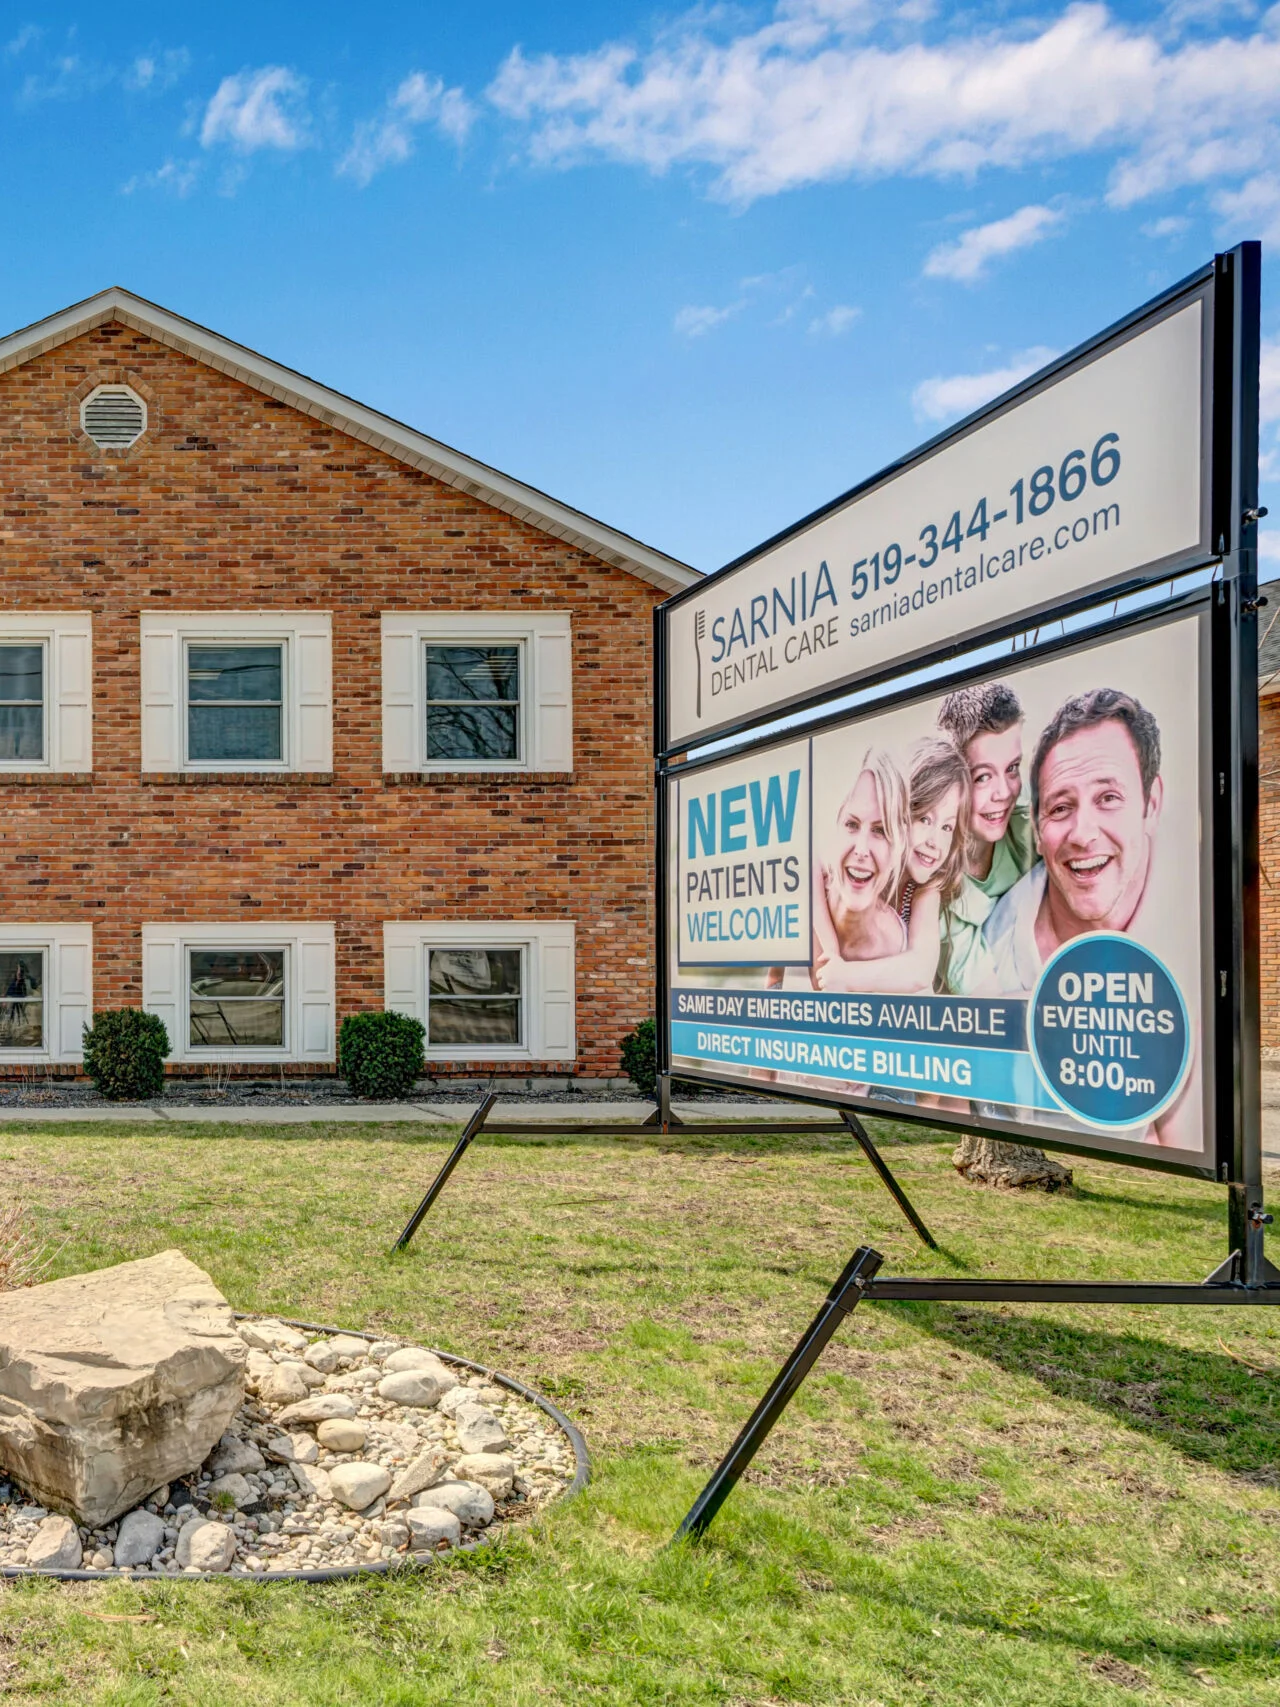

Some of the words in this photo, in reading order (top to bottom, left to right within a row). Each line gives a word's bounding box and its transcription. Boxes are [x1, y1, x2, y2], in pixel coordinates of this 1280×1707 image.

[851, 432, 1122, 601] 519-344-1866
[850, 502, 1121, 638] sarniadentalcare.com
[711, 559, 838, 663] SARNIA
[711, 651, 779, 697] DENTAL
[784, 616, 839, 664] CARE
[687, 769, 801, 860] NEW
[687, 855, 800, 903] PATIENTS
[687, 903, 800, 942] WELCOME
[1057, 971, 1154, 1005] OPEN
[677, 993, 716, 1016] SAME
[717, 996, 744, 1018] DAY
[746, 997, 873, 1027] EMERGENCIES
[877, 1002, 1006, 1037] AVAILABLE
[1042, 1005, 1175, 1036] EVENINGS
[696, 1031, 751, 1056] DIRECT
[754, 1037, 867, 1073] INSURANCE
[872, 1050, 972, 1087] BILLING
[1071, 1034, 1140, 1060] UNTIL
[1058, 1058, 1156, 1096] 8:00pm
